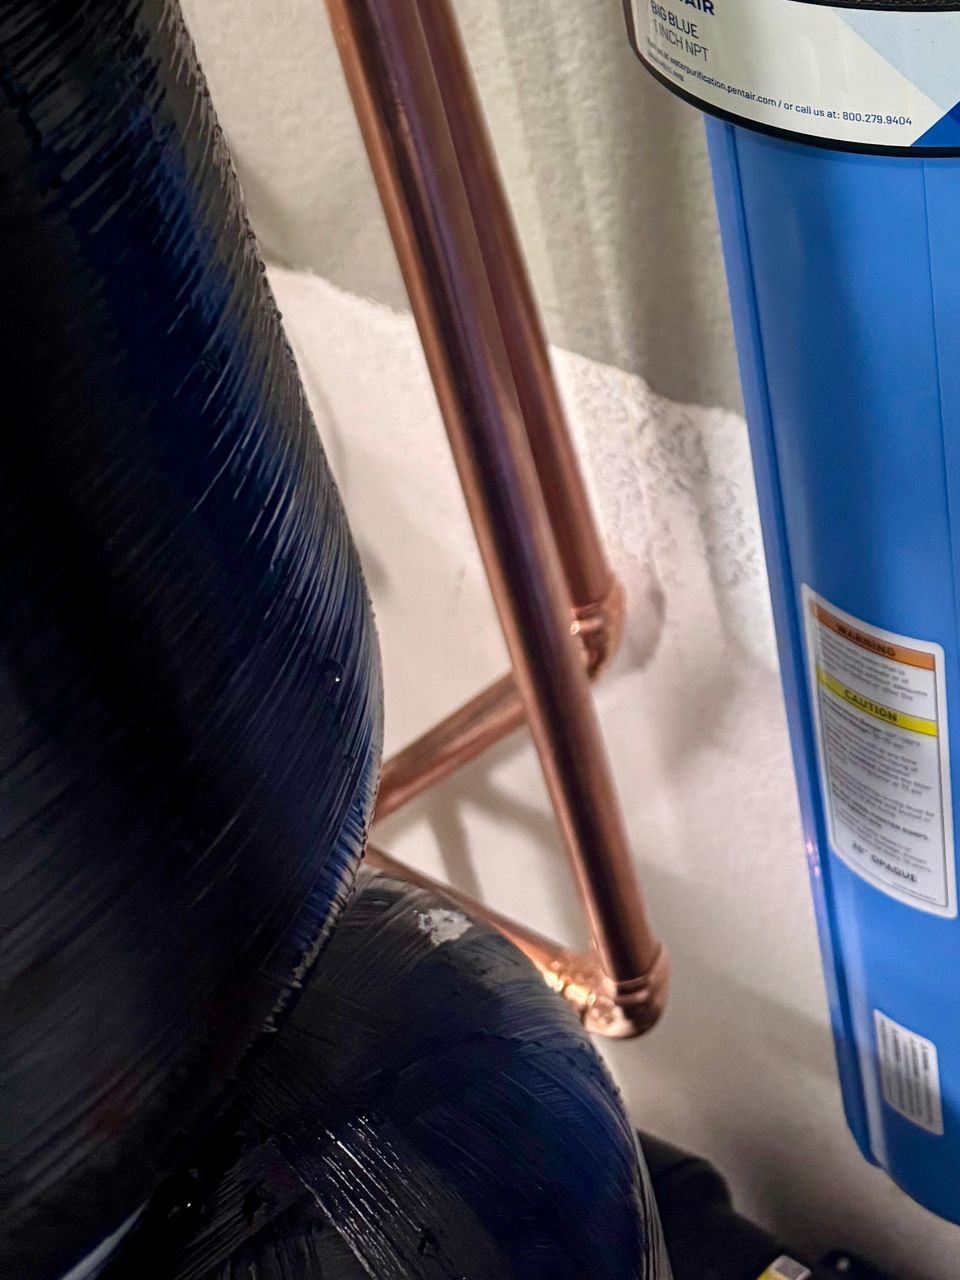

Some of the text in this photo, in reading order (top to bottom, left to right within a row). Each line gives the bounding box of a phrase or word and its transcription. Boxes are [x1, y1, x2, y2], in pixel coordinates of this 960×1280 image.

[650, 0, 699, 39] BIG BLUE
[659, 22, 684, 50] INCH
[685, 39, 709, 62] NPT
[670, 57, 777, 107] waterpurification.pentair.com
[784, 102, 793, 111] or
[795, 103, 812, 115] call
[813, 109, 825, 117] us
[826, 111, 840, 120] at:
[842, 111, 912, 126] 800.279.9404
[835, 622, 897, 657] WARNING
[844, 689, 898, 722] CAUTION
[870, 852, 918, 883] OPAQUE
